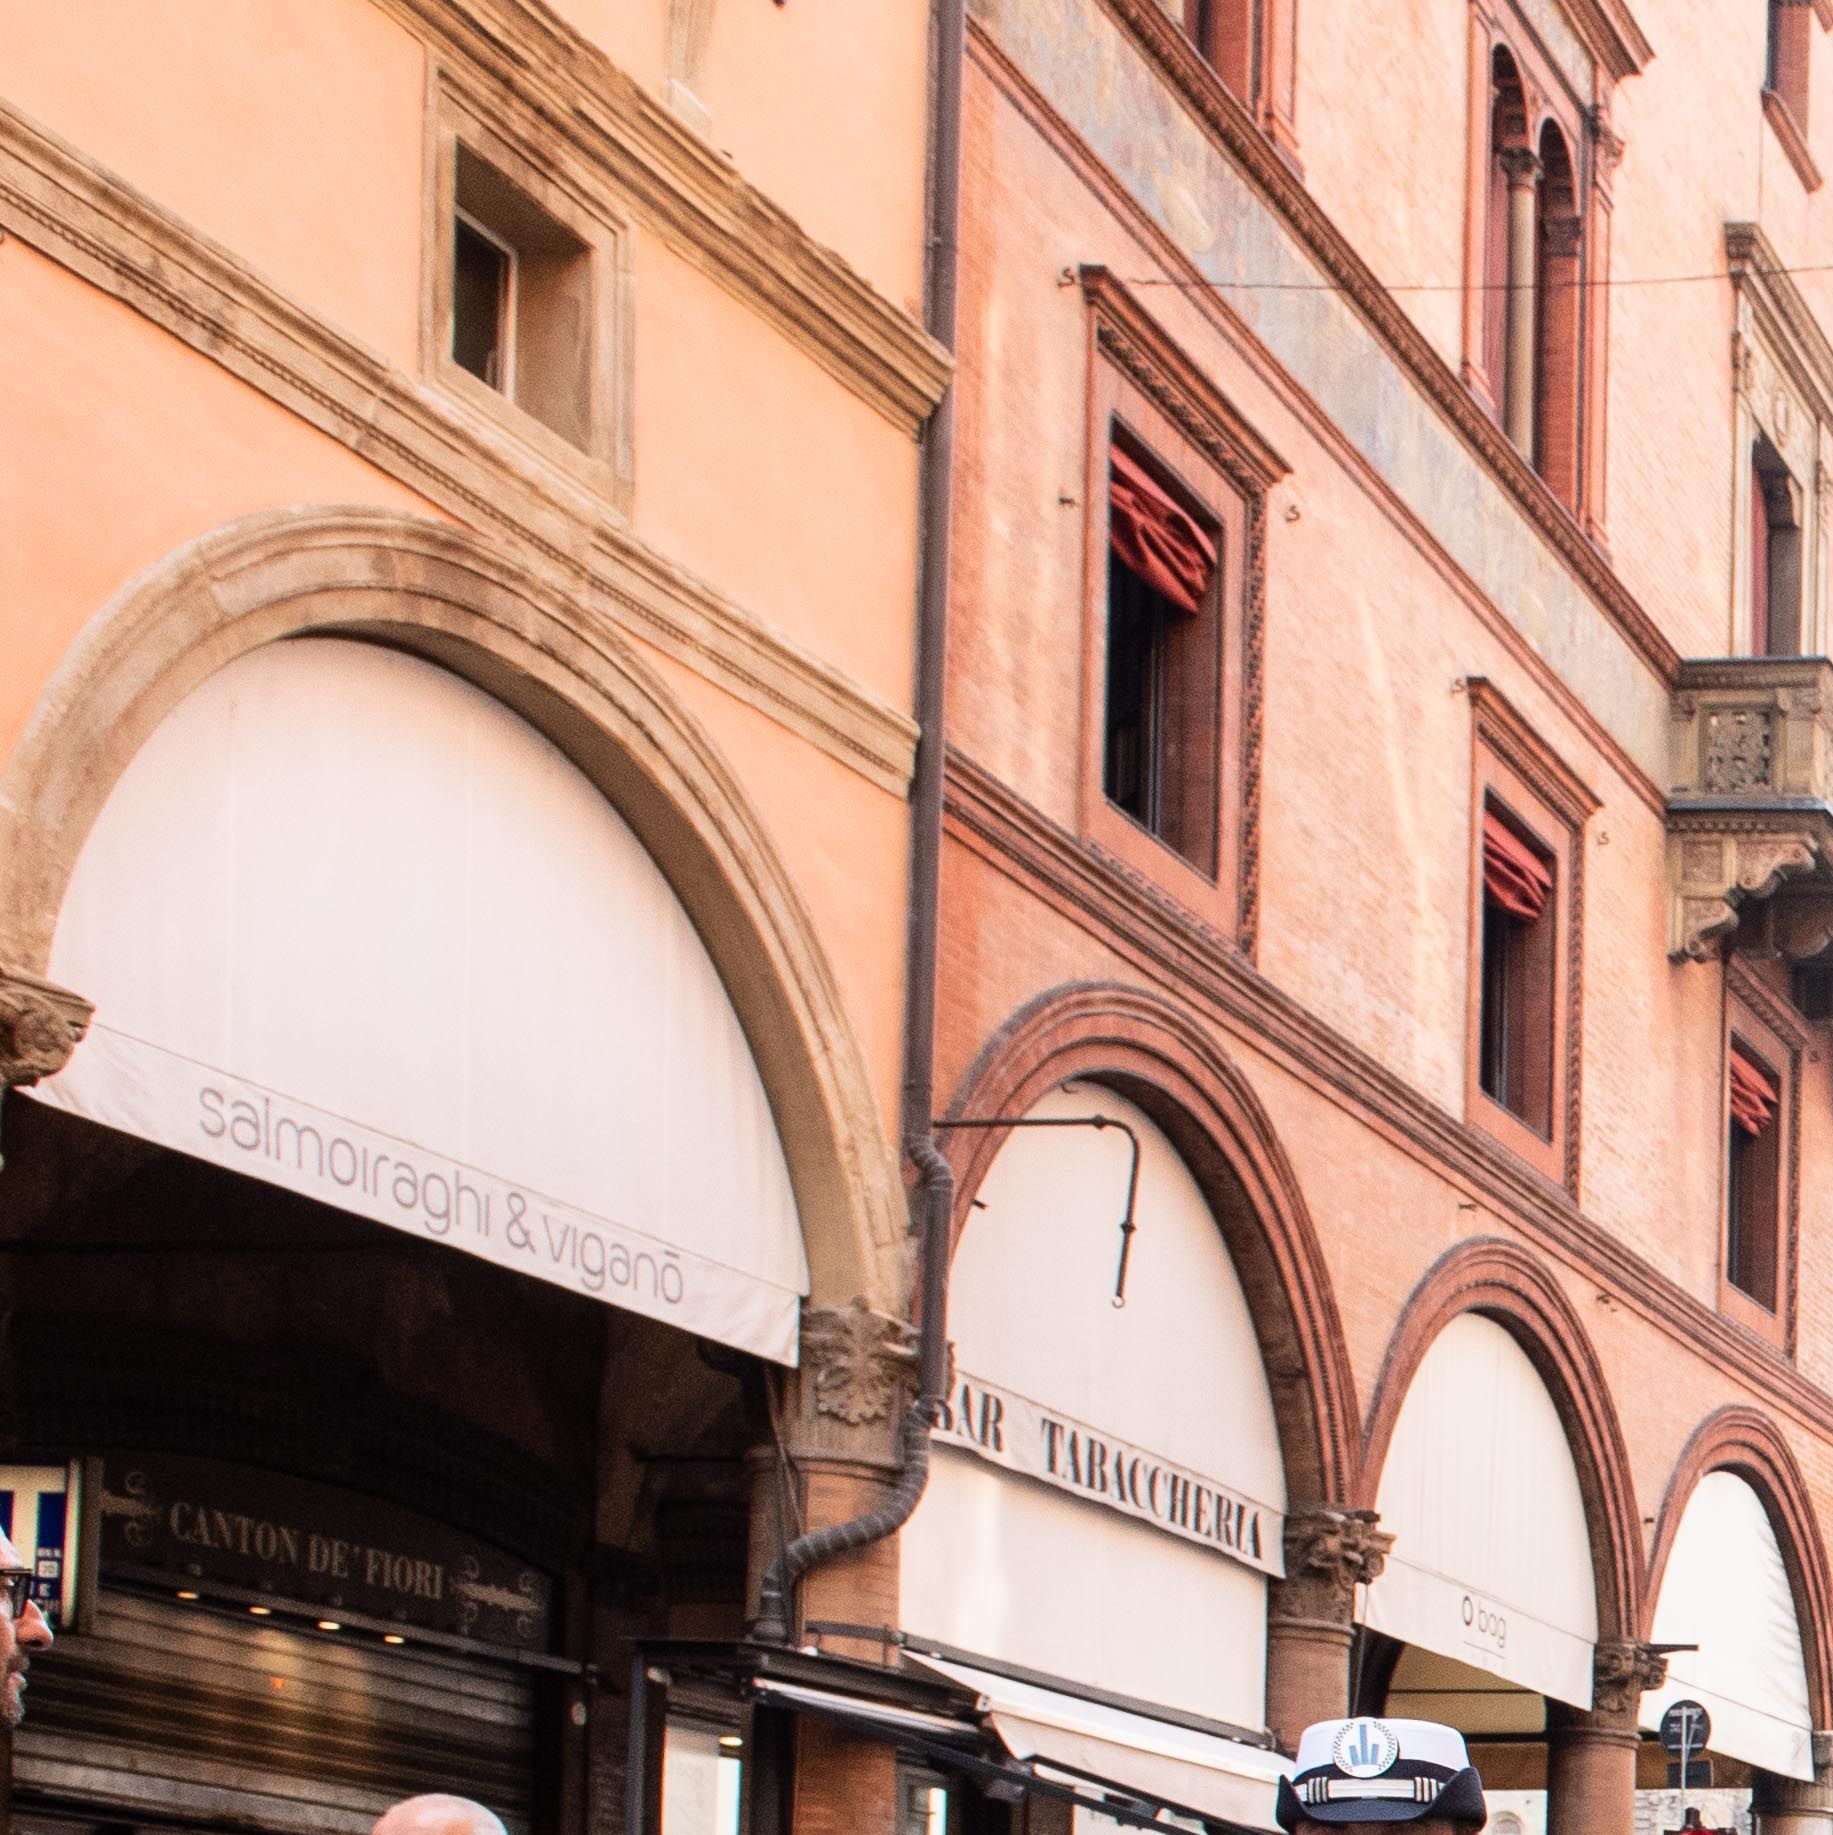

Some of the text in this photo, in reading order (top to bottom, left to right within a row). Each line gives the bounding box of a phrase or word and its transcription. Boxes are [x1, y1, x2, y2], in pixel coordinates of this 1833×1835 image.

[199, 1086, 491, 1236] salmoiraghi
[506, 1192, 537, 1254] &
[1040, 1417, 1263, 1560] TABACCHERIA
[169, 1502, 298, 1566] CANTON
[365, 1548, 443, 1599] FIORI
[1479, 1599, 1506, 1648] bag
